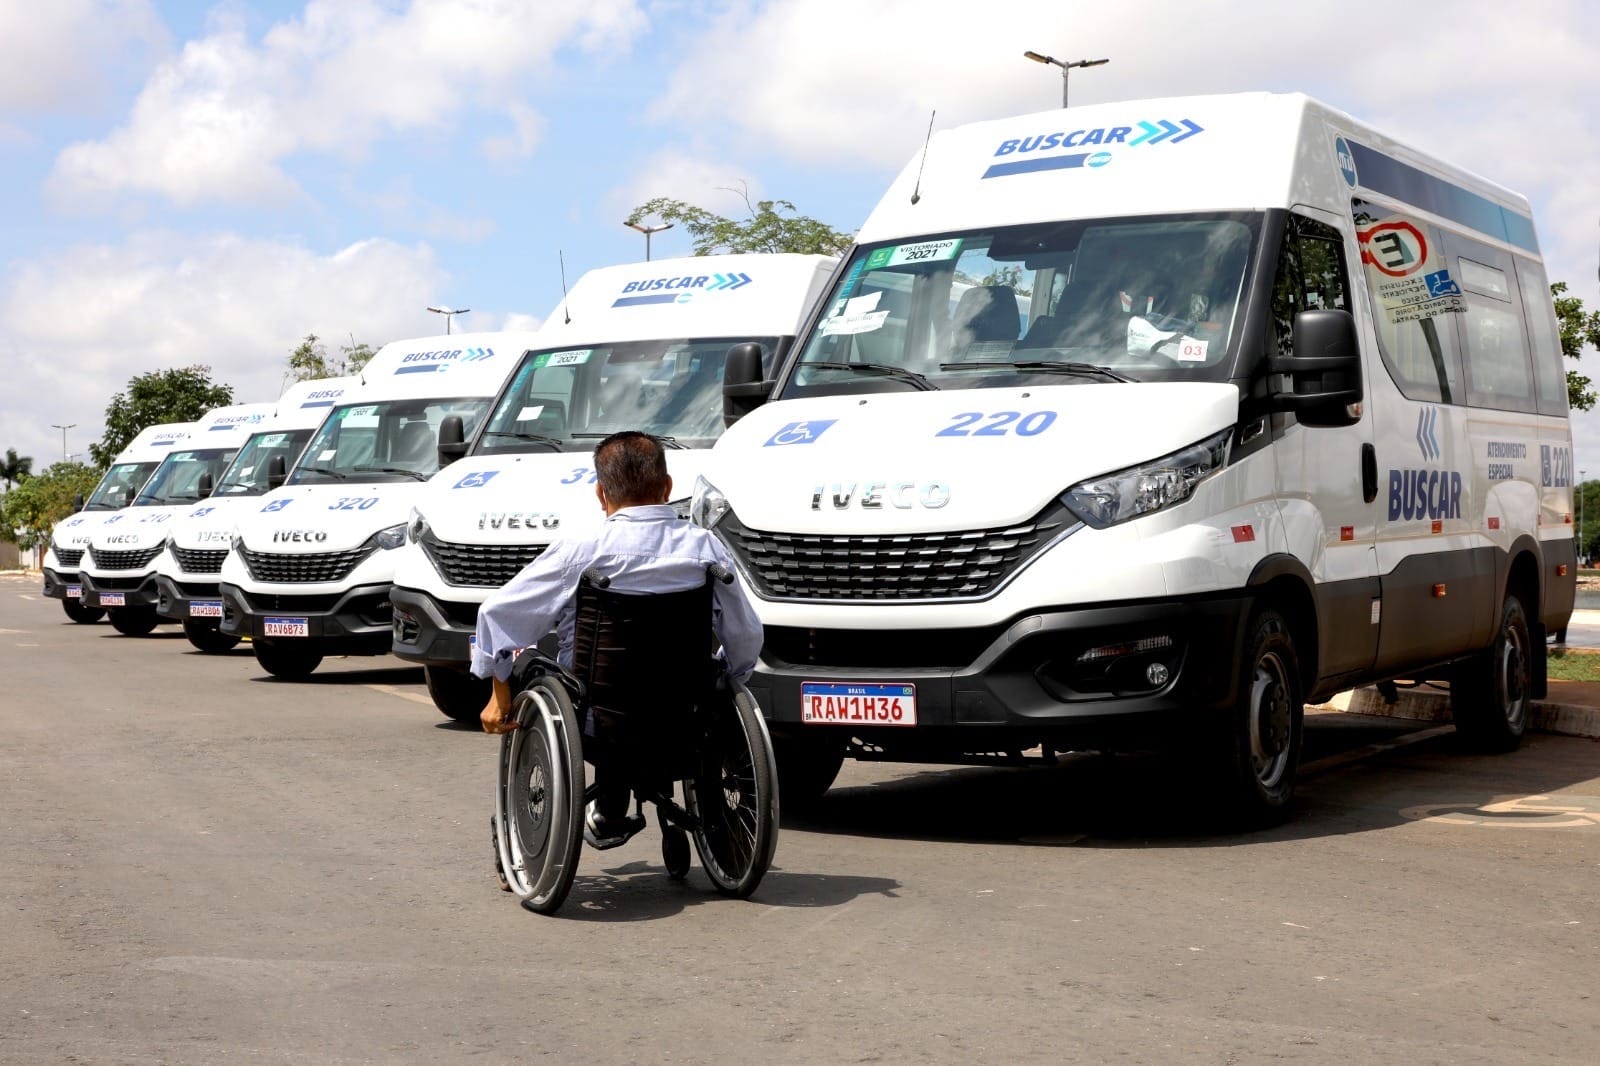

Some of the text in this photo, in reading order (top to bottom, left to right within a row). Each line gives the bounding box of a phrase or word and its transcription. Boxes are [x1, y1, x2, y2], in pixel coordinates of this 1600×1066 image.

[993, 126, 1132, 157] BUSCAR
[900, 242, 953, 253] VISTORIADO
[905, 249, 938, 261] 2021
[622, 275, 710, 293] BUSCAR
[402, 349, 462, 363] BUSCAR
[1183, 345, 1203, 356] 03
[934, 410, 1058, 437] 220
[1487, 441, 1527, 459] ATENDIMENTO
[1488, 464, 1514, 480] ESPECIAL
[1553, 447, 1570, 487] 220
[328, 497, 380, 510] 320
[811, 480, 952, 511] IVECO
[1388, 470, 1462, 521] BUSCAR
[478, 512, 561, 530] IVECO
[107, 534, 139, 544] IVECO
[273, 531, 327, 543] IVECO
[268, 624, 304, 635] RAV6B73
[811, 695, 903, 720] RAW1H36
